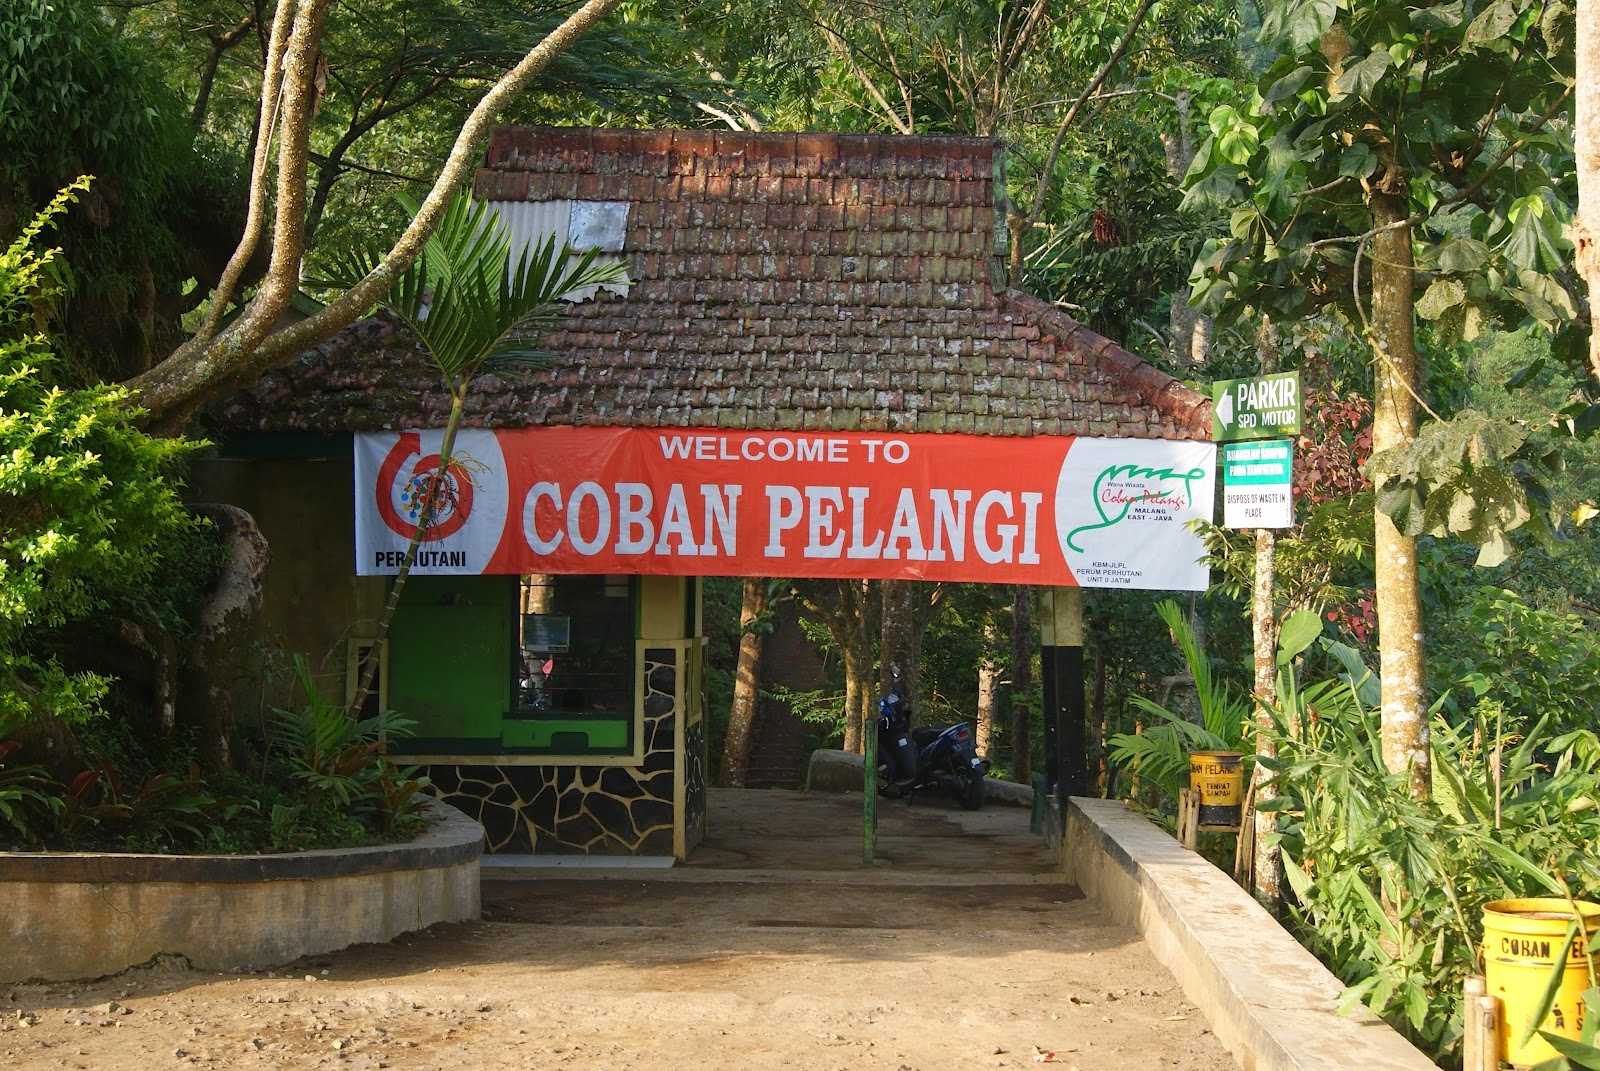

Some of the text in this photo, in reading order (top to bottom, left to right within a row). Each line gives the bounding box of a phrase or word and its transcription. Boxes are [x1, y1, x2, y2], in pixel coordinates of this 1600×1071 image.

[1237, 377, 1296, 411] PARKIR
[1238, 409, 1296, 428] SPD MOTOR
[659, 435, 910, 464] WELCOME TO
[1102, 488, 1185, 511] Coban Pelangi
[1227, 493, 1286, 504] DISPOSE OF WASTE IN
[522, 481, 1043, 565] COBAN PELANGI
[1245, 508, 1262, 517] PLACE
[1103, 569, 1142, 577] PERHUTANI
[1501, 937, 1550, 958] COBAN
